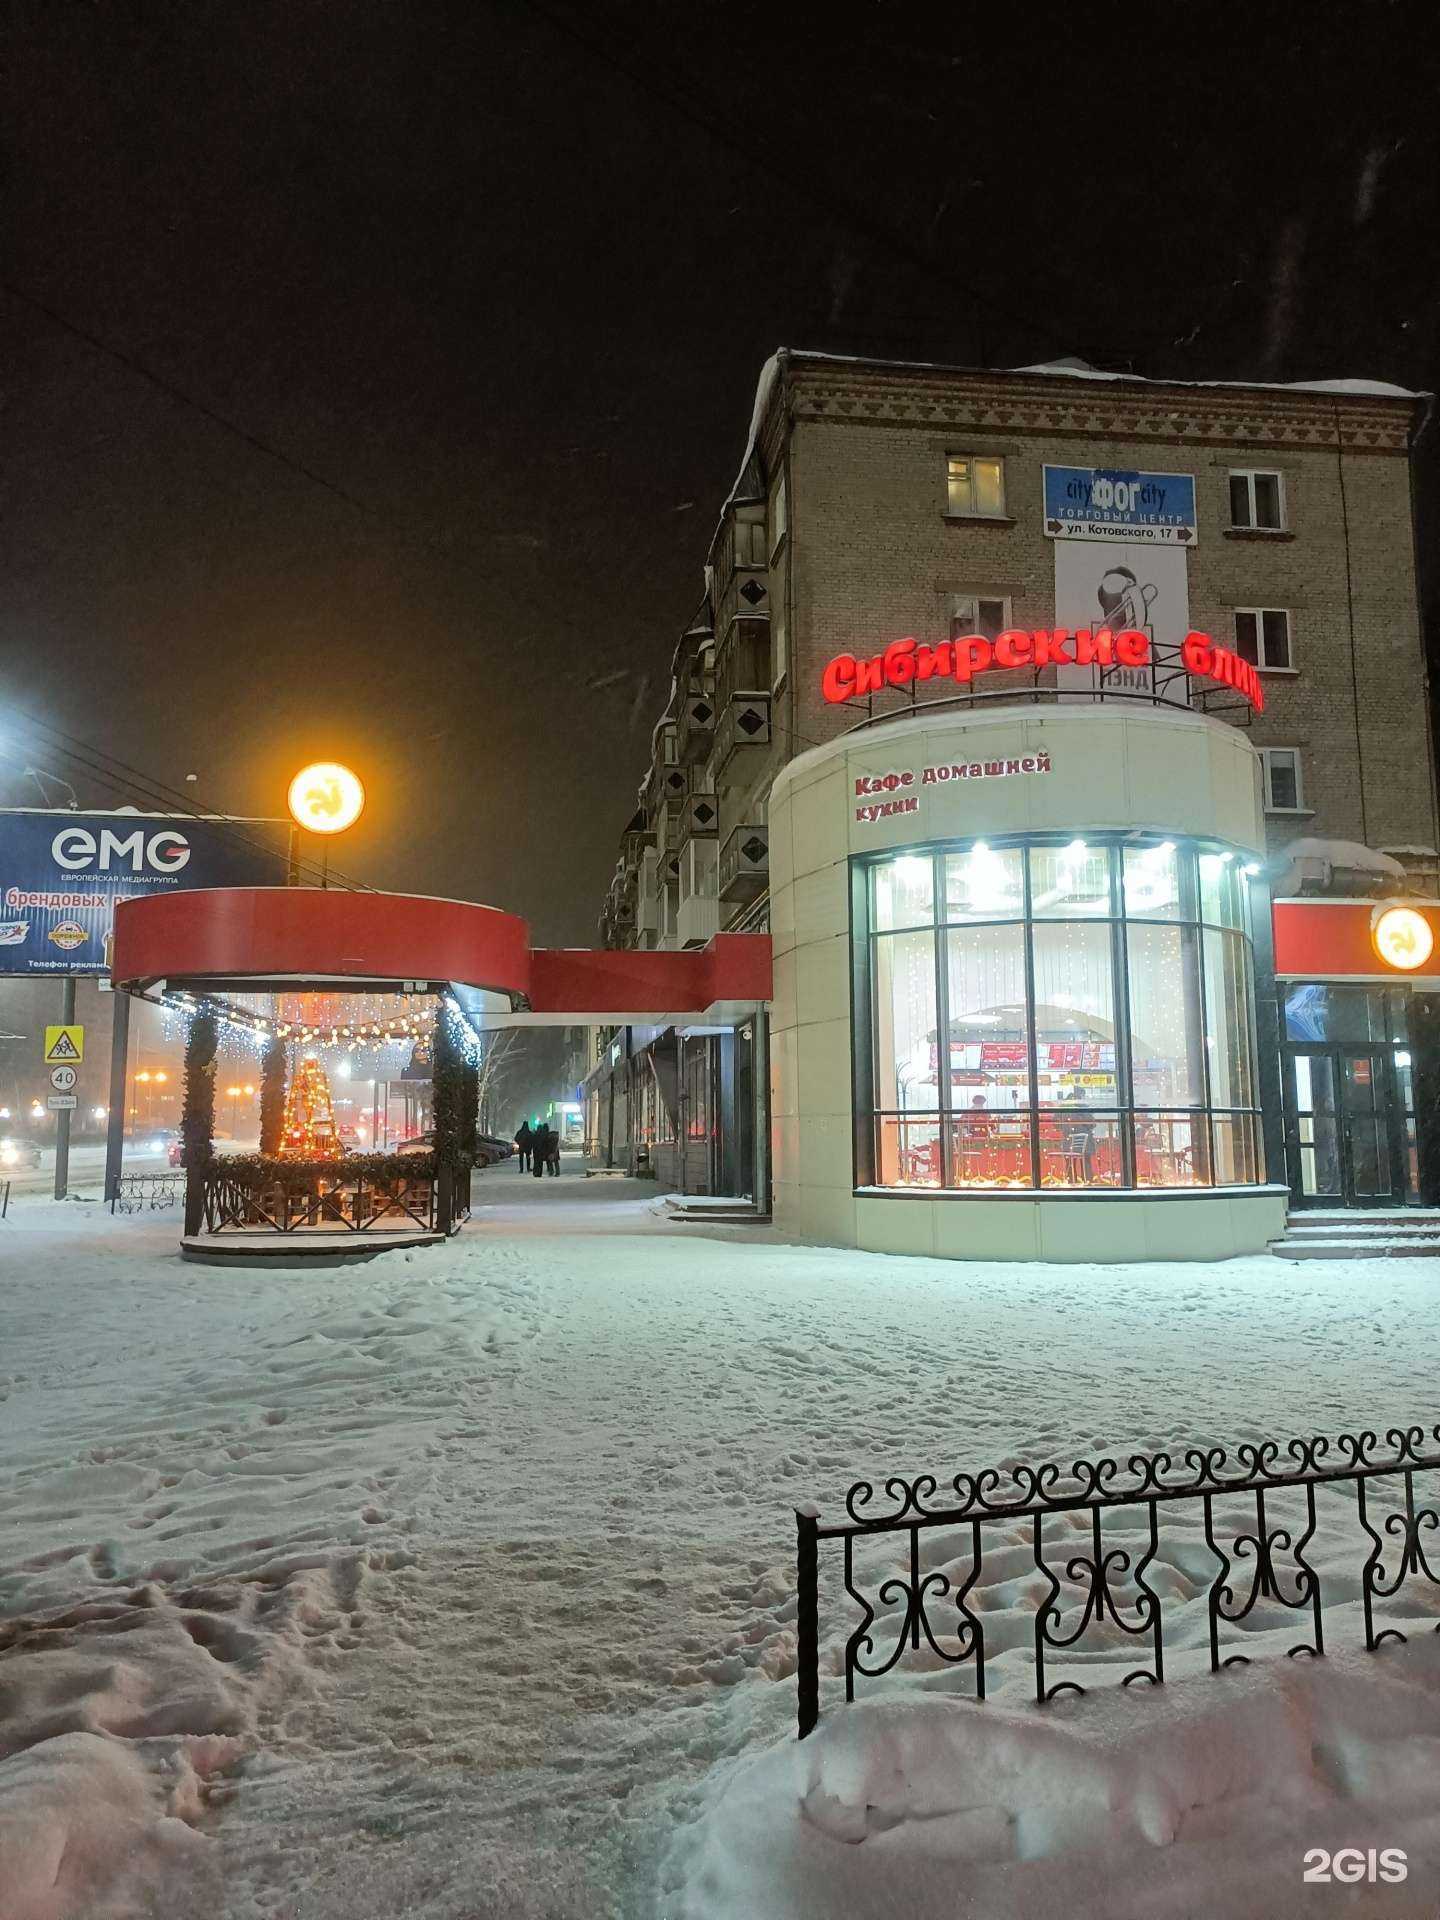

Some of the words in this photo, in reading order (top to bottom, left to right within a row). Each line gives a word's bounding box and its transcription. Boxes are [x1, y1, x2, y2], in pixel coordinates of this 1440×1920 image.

[1059, 507, 1131, 522] ТОРГОВЫЙ
[1140, 513, 1183, 525] ЦЕНТР
[1067, 524, 1086, 537] ул.
[1088, 525, 1157, 540] Котовского,
[1160, 528, 1172, 538] 17
[822, 628, 1150, 704] Сибирские
[855, 771, 914, 796] Кафе
[921, 752, 1052, 785] домашней
[856, 797, 920, 822] кухни
[61, 874, 119, 883] ЕВРОПЕЙСКАЯ
[121, 875, 178, 884] МЕДИАГРУППА
[7, 889, 106, 910] брендовых
[28, 960, 68, 970] Телефон
[55, 1072, 74, 1084] 40
